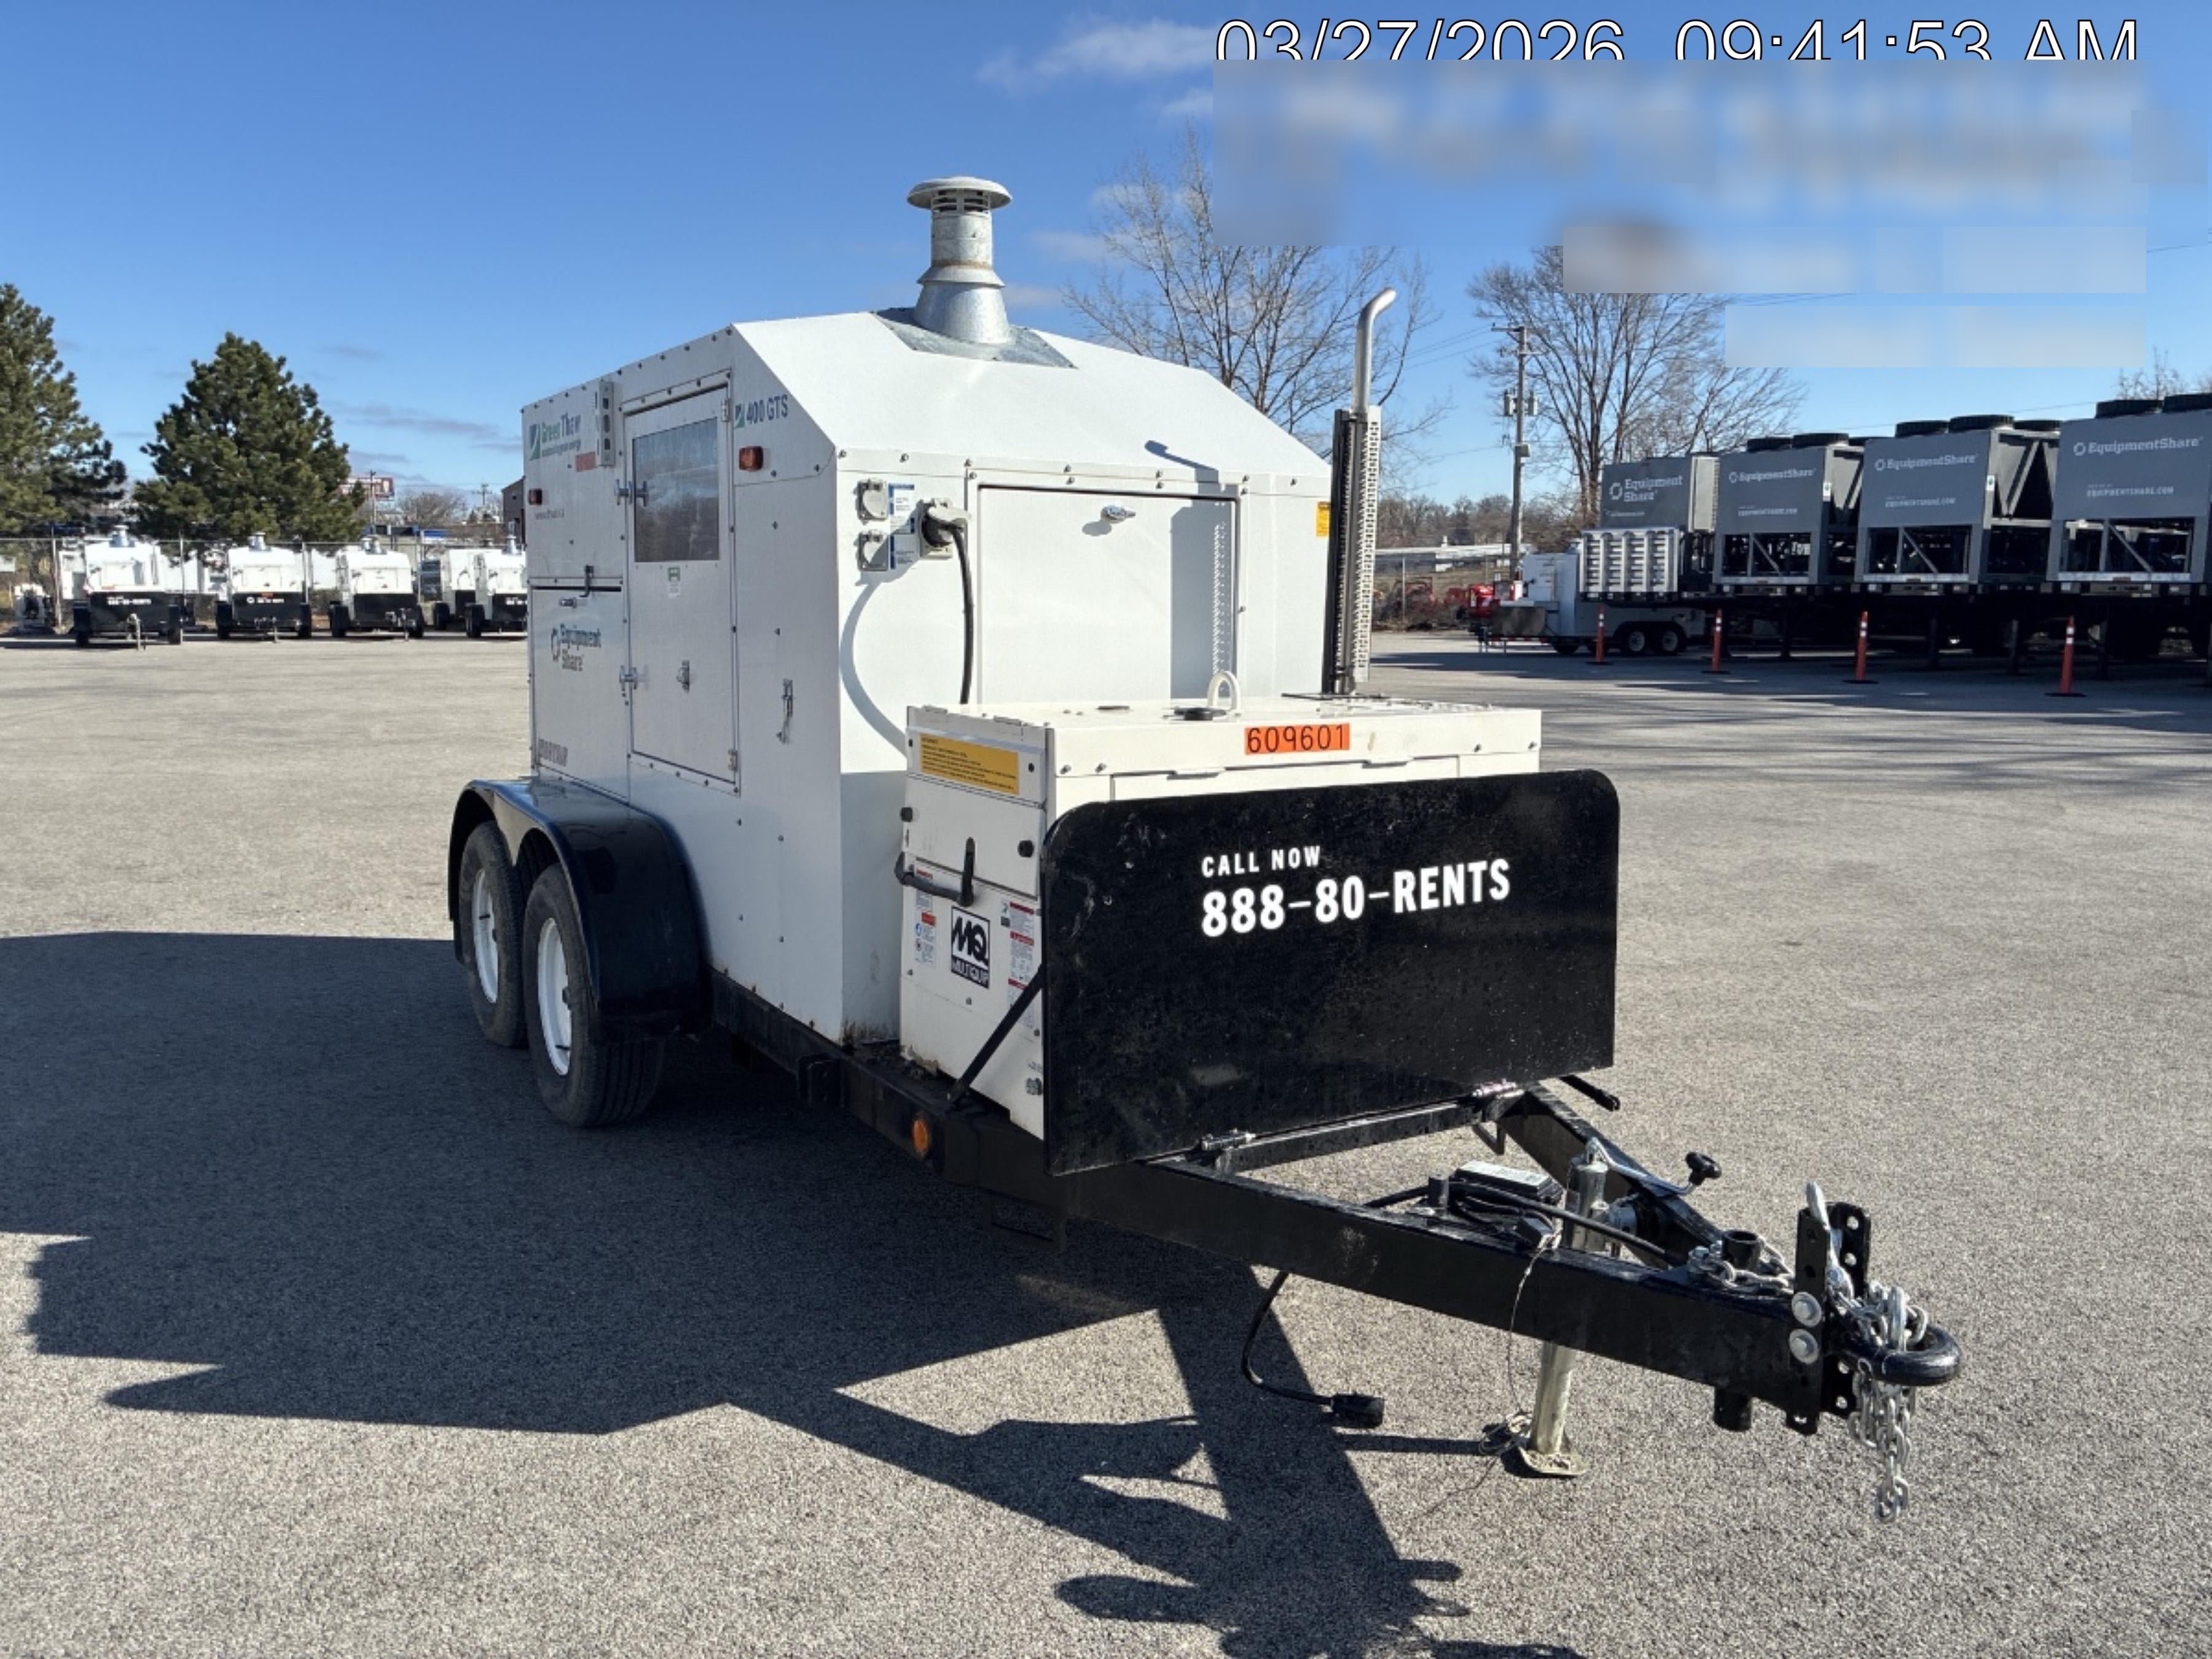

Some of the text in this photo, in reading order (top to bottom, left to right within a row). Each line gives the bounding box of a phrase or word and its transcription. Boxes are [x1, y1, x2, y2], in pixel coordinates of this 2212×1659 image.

[747, 394, 788, 424] 400 GTS
[2087, 437, 2200, 455] EquipmentShare
[1886, 454, 1976, 469] EquipmentShare
[1625, 475, 1683, 491] Equipment
[1623, 491, 1655, 502] Share
[1247, 724, 1346, 754] 609601
[1201, 845, 1321, 877] CALL NOW
[1201, 858, 1512, 938] 888-80-RENTS
